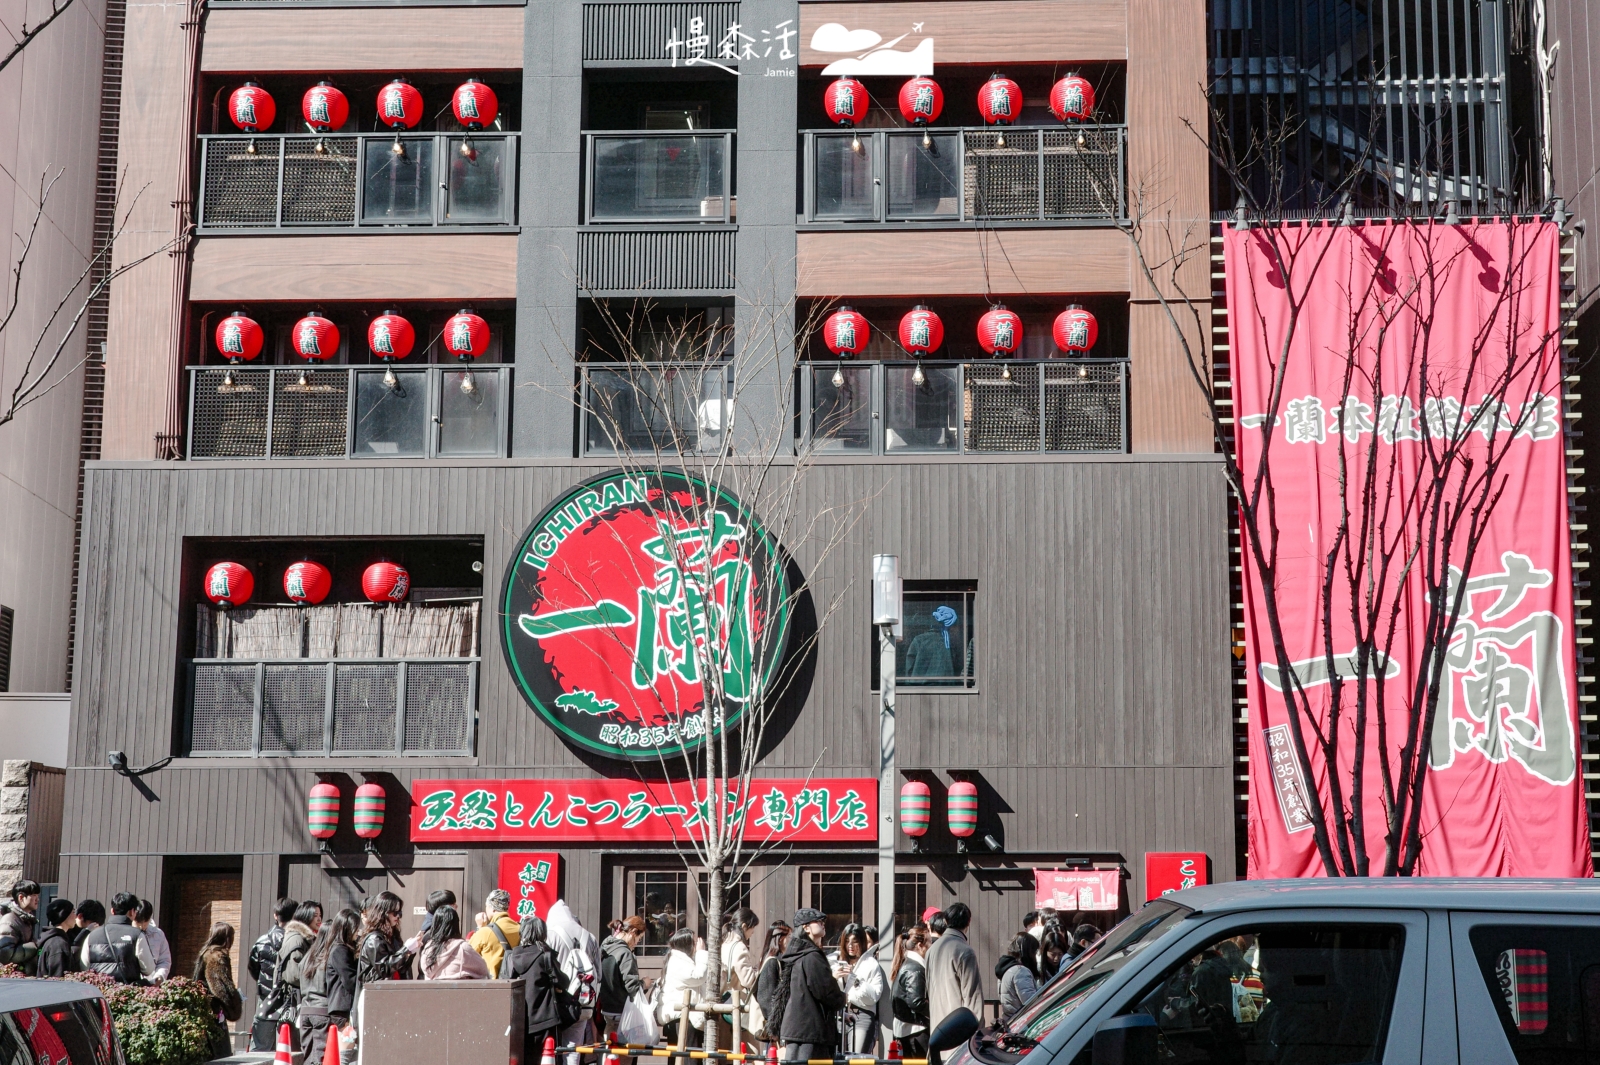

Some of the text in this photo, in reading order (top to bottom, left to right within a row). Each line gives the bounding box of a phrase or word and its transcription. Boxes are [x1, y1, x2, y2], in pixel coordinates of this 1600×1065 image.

[236, 88, 258, 124] 一蘭
[309, 86, 331, 123] 一蘭
[385, 82, 406, 119] 一蘭
[458, 83, 479, 119] 一蘭
[835, 79, 855, 116] 一蘭
[914, 79, 934, 116] 一蘭
[991, 80, 1012, 116] 一蘭
[1063, 79, 1084, 116] 一蘭
[223, 317, 245, 354] 一蘭
[300, 319, 322, 355] 一蘭
[373, 318, 395, 354] 一蘭
[452, 316, 473, 352] 一蘭
[835, 312, 856, 350] 一蘭
[911, 312, 931, 348] 一蘭
[993, 313, 1014, 350] 一蘭
[1067, 312, 1089, 349] 一蘭
[1239, 392, 1561, 444] 一蘭本社総本店
[523, 476, 648, 572] ICHIRAN
[210, 562, 232, 598] 一蘭
[286, 562, 307, 598] 一蘭
[517, 510, 756, 703] 一蘭
[1258, 550, 1577, 787] 一蘭
[1267, 731, 1308, 824] 昭和35年創業
